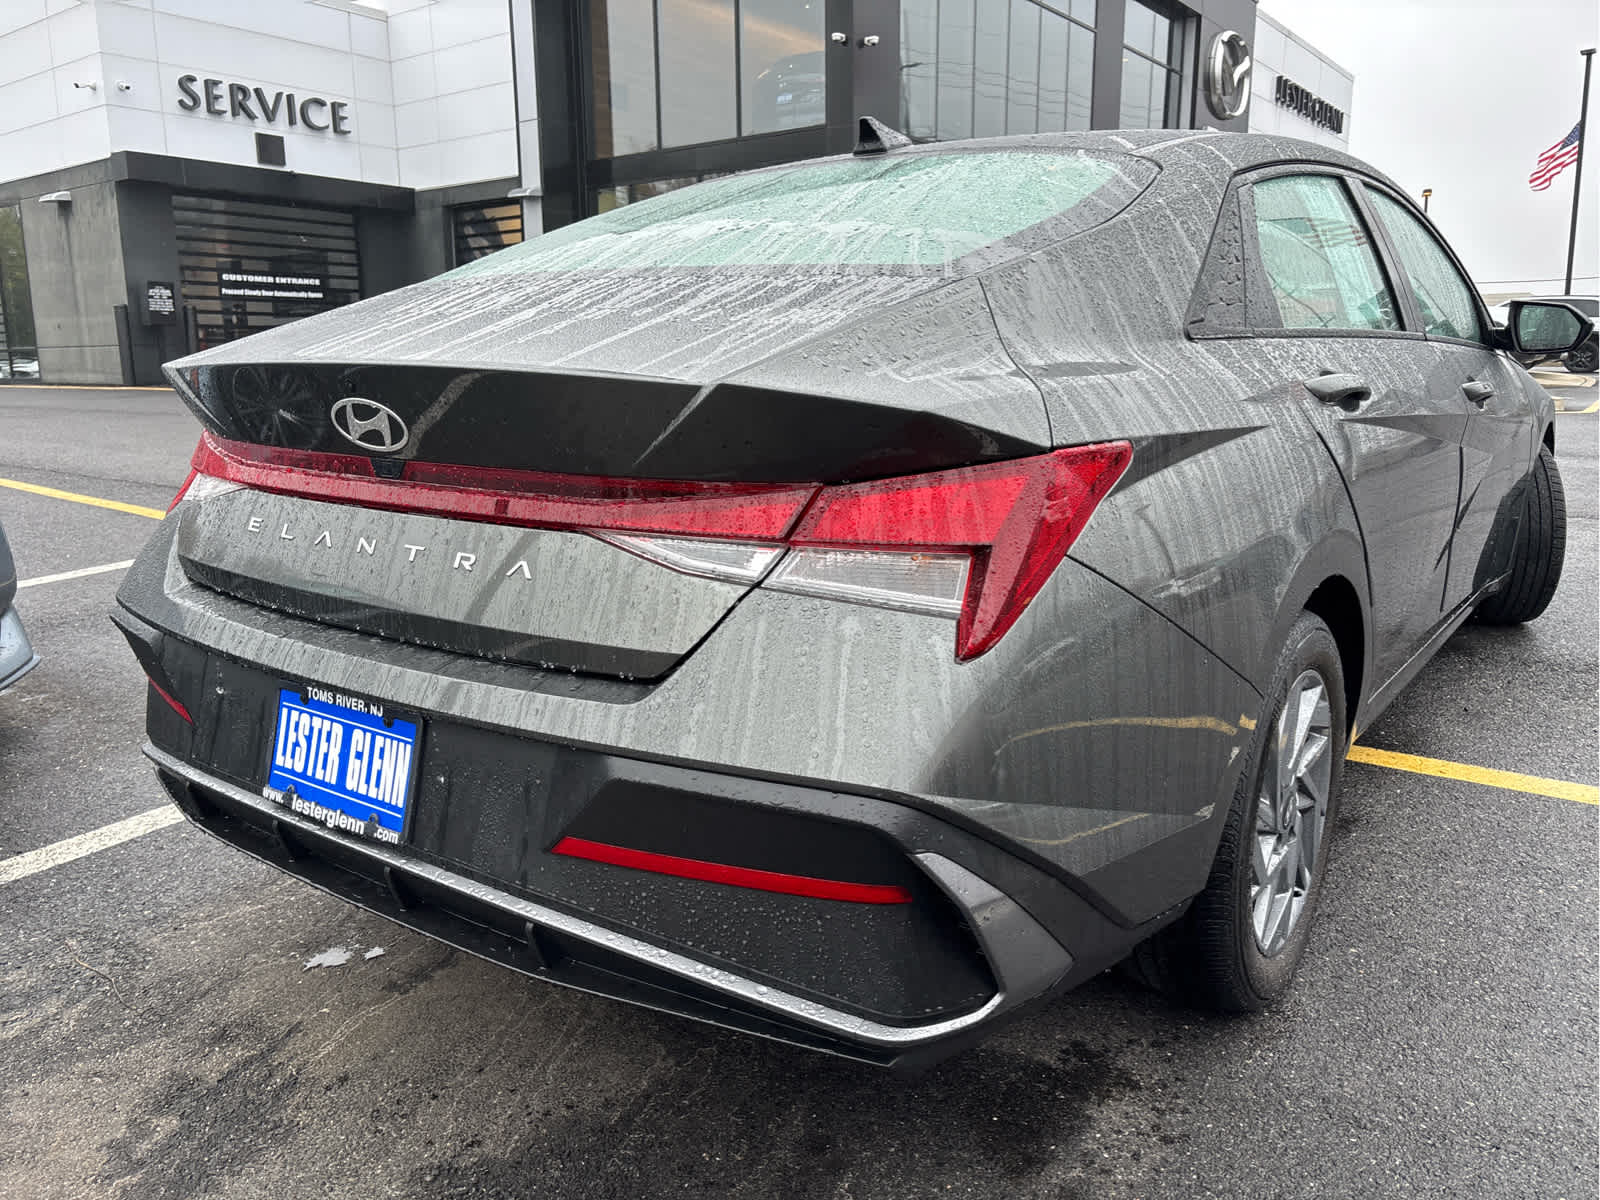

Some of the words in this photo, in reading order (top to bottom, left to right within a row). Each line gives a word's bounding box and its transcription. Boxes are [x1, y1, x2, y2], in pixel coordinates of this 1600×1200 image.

[177, 74, 351, 135] SERVICE
[1275, 75, 1312, 118] LESTER
[1310, 97, 1344, 134] GLENN
[222, 273, 274, 284] CUSTOMER
[275, 276, 321, 286] ENTRANCE
[248, 516, 533, 580] ELANTRA
[307, 686, 334, 705] TOMS
[335, 693, 368, 713] RIVER,
[370, 703, 384, 718] NJ
[275, 707, 343, 785] LESTER
[345, 728, 412, 809] GLENN
[291, 794, 365, 835] lesterglenn
[373, 827, 400, 845] .com
